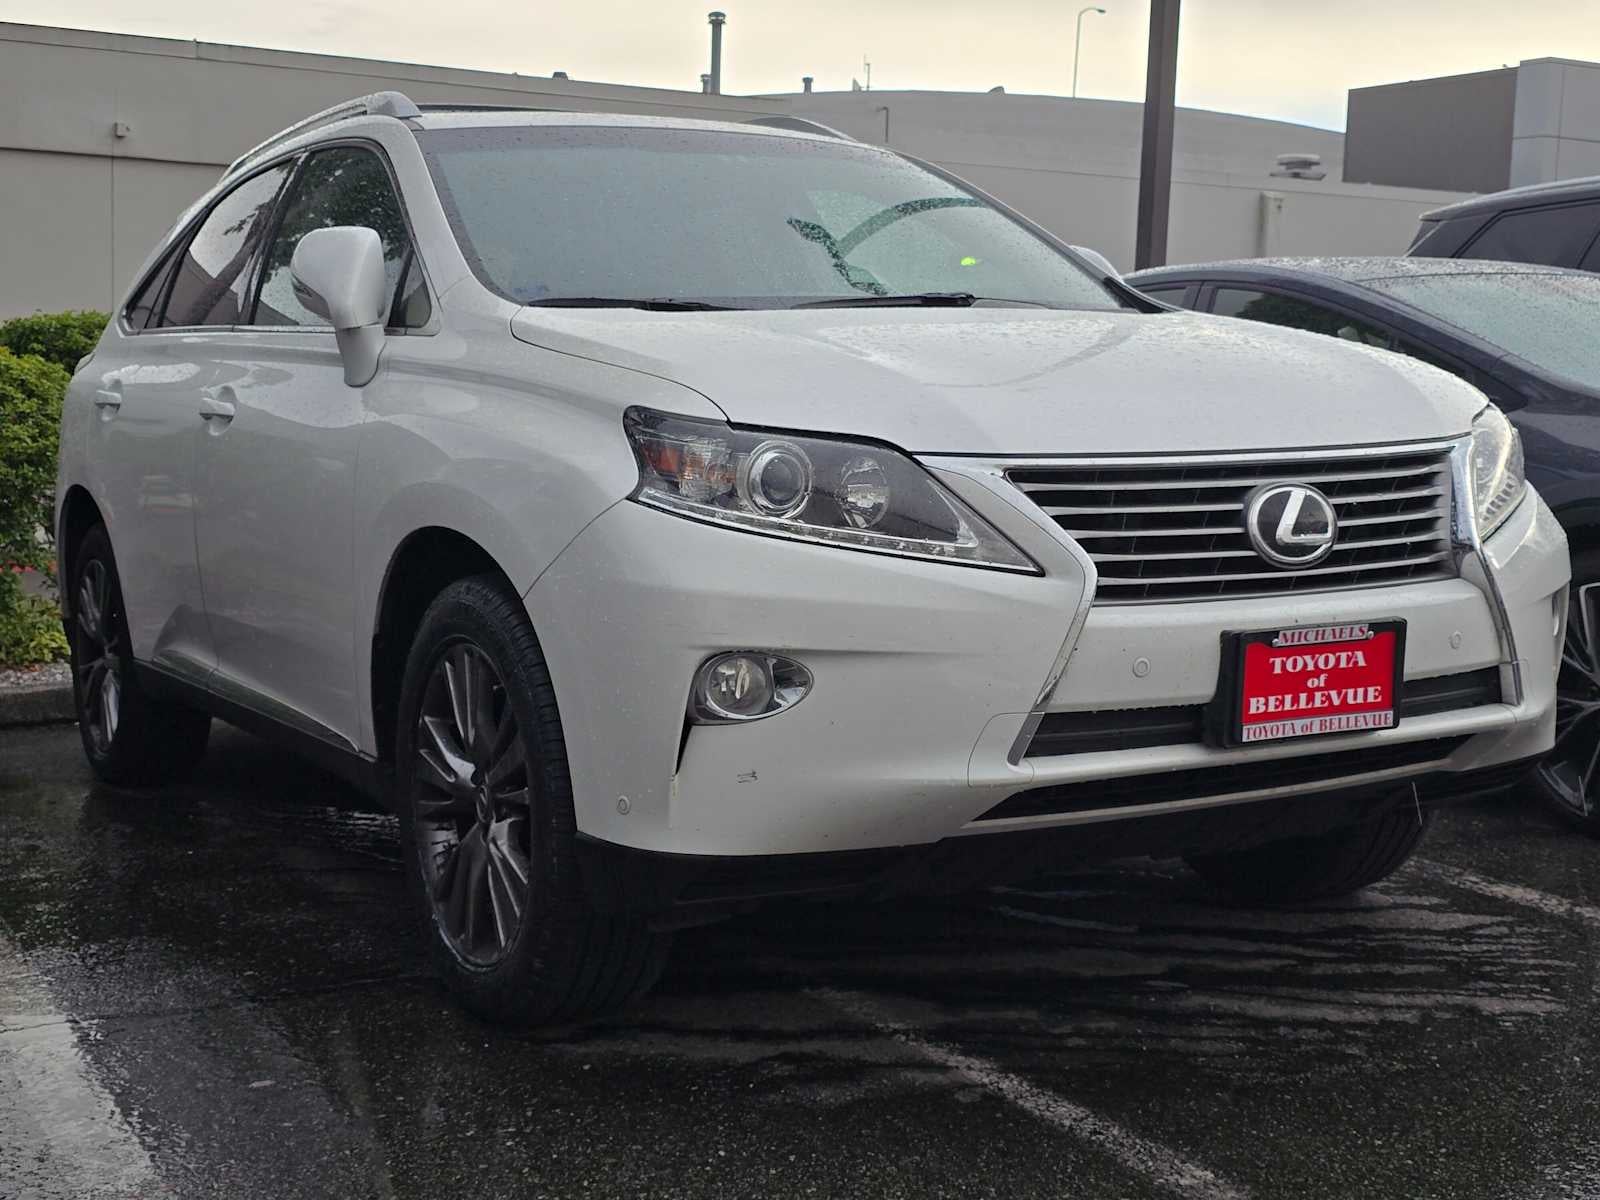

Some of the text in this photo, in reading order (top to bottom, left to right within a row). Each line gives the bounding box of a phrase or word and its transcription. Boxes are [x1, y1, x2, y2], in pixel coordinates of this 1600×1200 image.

[1281, 626, 1366, 644] MICHAELS
[1269, 651, 1367, 674] TOYOTA
[1307, 674, 1328, 688] of
[1248, 686, 1382, 714] BELLEVUE
[1245, 713, 1391, 740] TOYOTA of BELLEVUE
